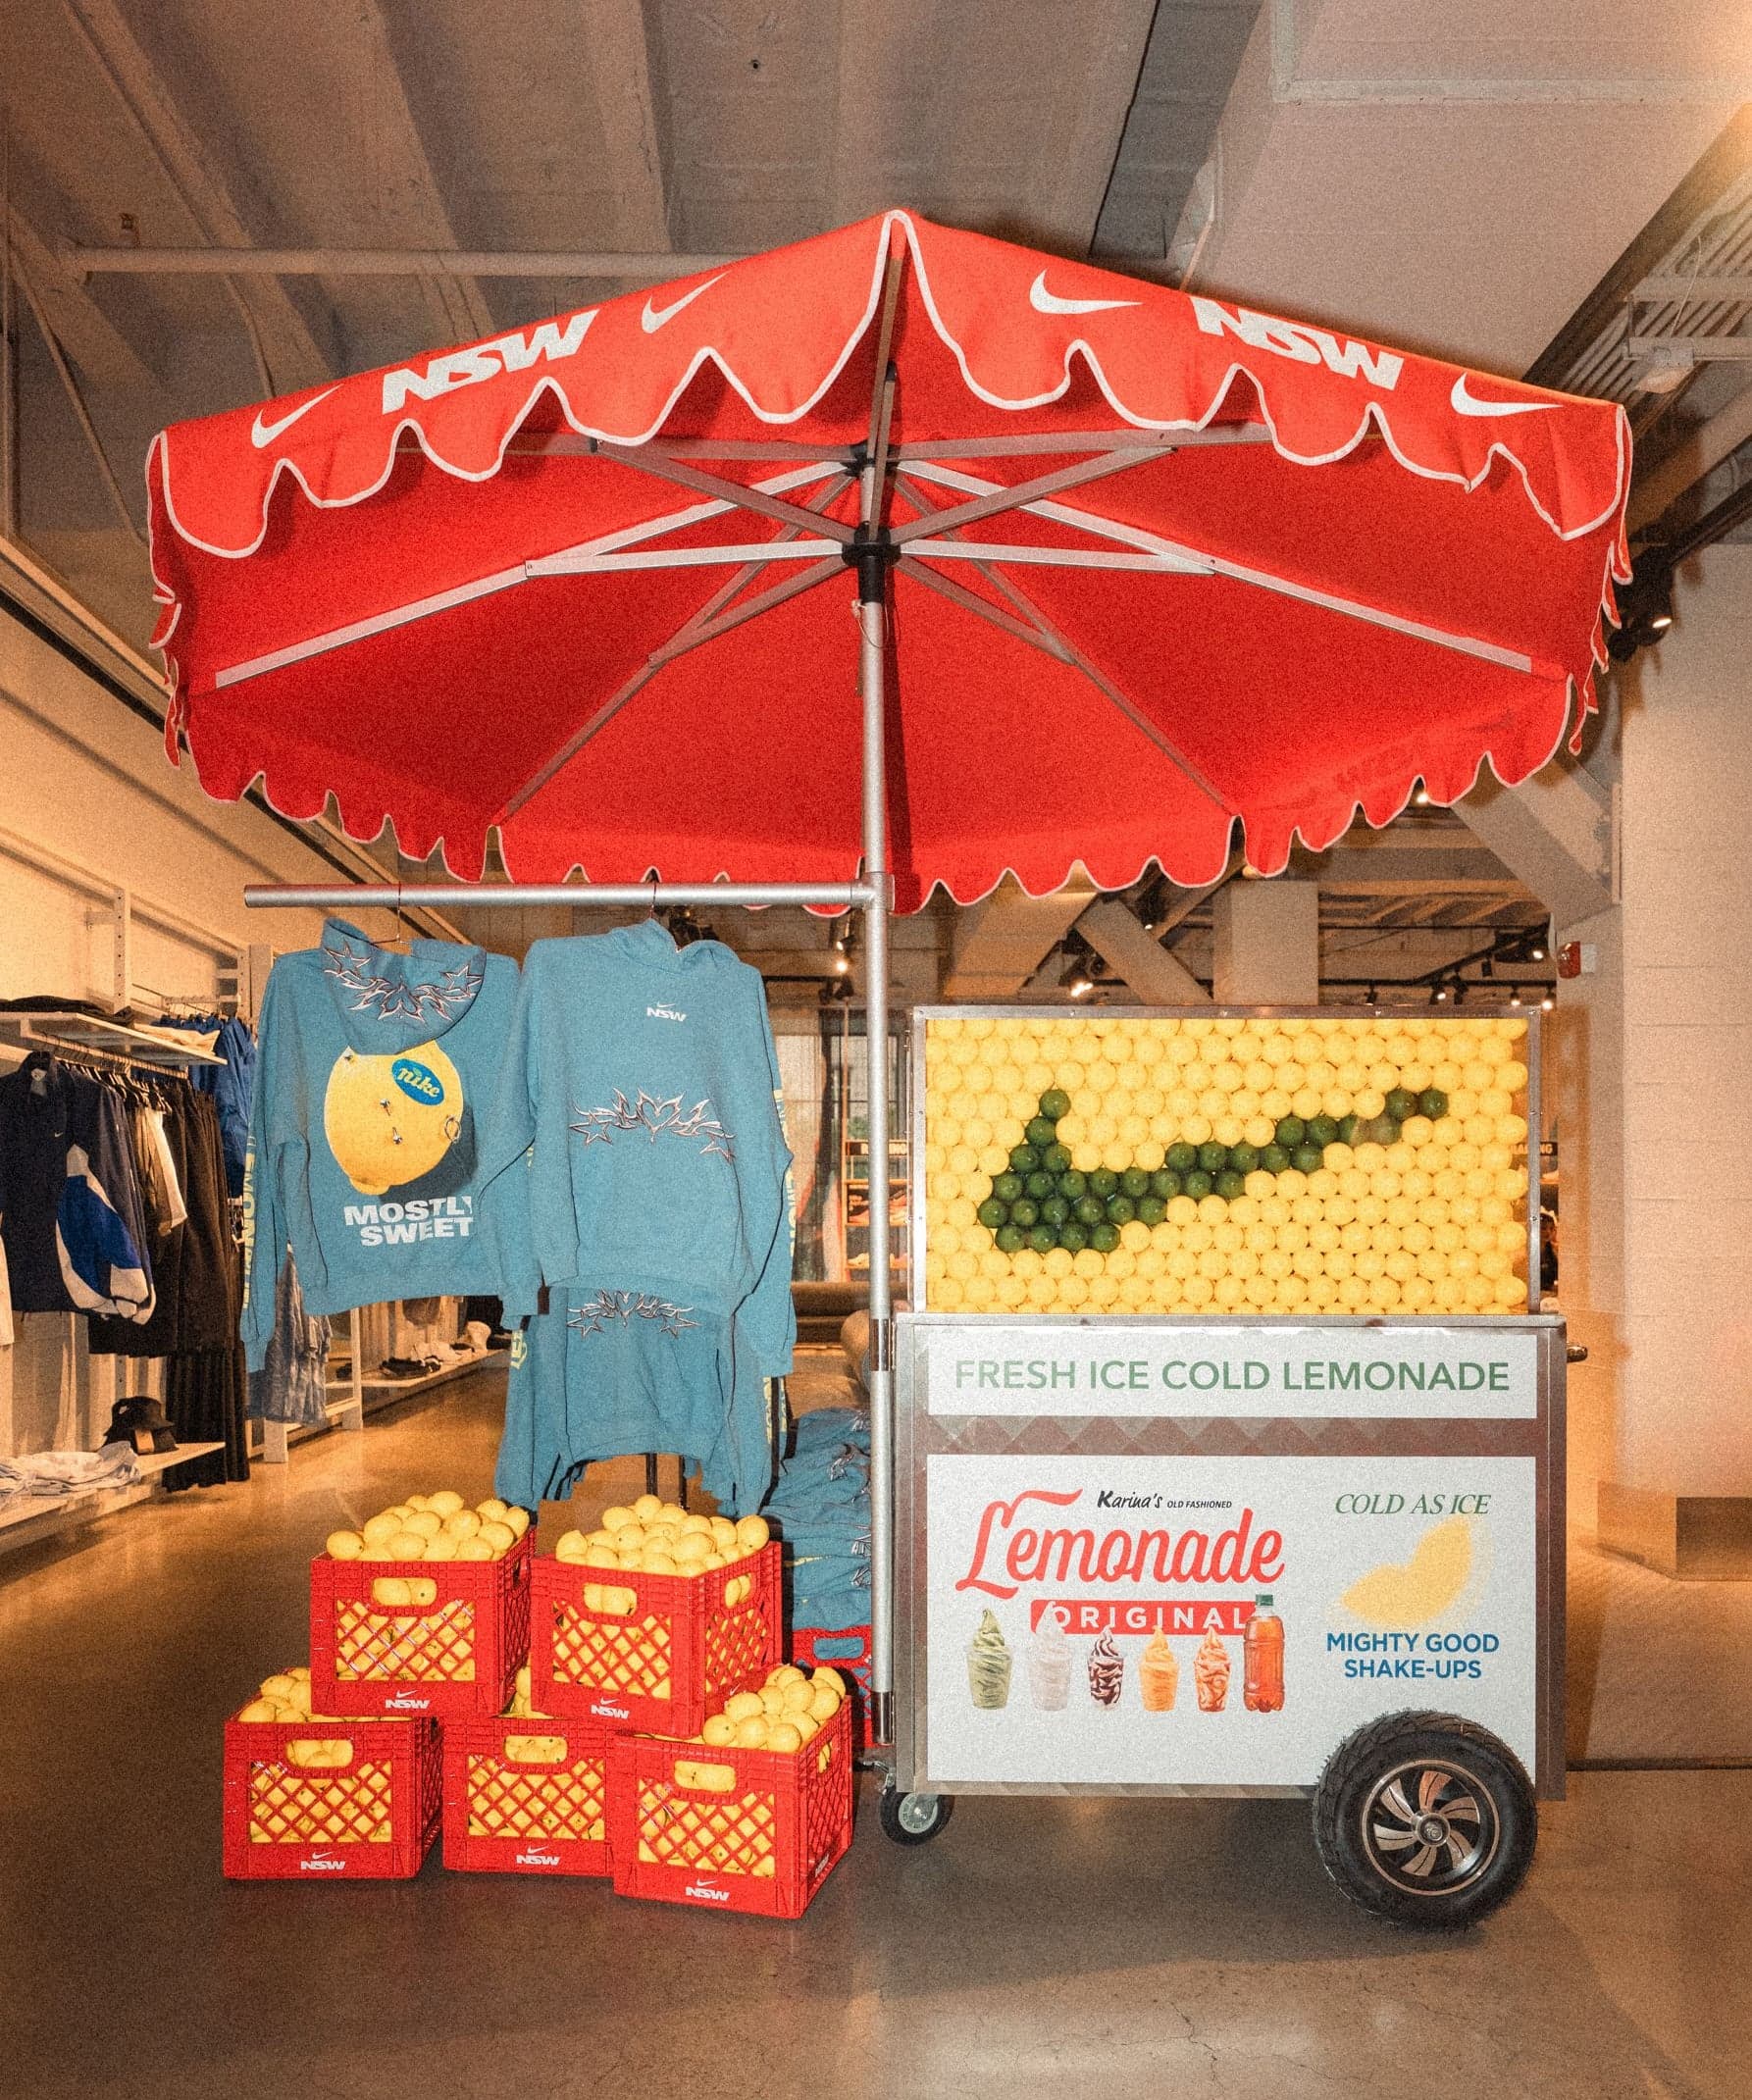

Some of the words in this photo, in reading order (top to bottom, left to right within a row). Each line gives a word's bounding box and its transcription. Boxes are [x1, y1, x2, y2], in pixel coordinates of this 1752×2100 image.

[1189, 296, 1404, 389] NSW
[382, 309, 600, 414] NSW
[646, 1006, 687, 1021] NSW
[396, 1066, 440, 1098] nike
[360, 1216, 474, 1246] SWEET
[955, 1360, 1076, 1389] FRESH
[1090, 1360, 1150, 1389] ICE
[1161, 1360, 1270, 1391] COLD
[1283, 1360, 1510, 1391] LEMONADE
[1166, 1500, 1184, 1509] OLD
[1186, 1500, 1232, 1509] FASHIONED
[1335, 1494, 1405, 1514] COLD
[1411, 1494, 1445, 1514] AS
[1451, 1494, 1492, 1515] ICE
[954, 1488, 1285, 1600] Lemonade
[1052, 1606, 1249, 1629] ORIGINAL
[1326, 1632, 1419, 1652] MIGHTY
[1425, 1633, 1500, 1652] GOOD
[1344, 1659, 1482, 1678] SHAKE-UPS
[385, 1699, 431, 1709] NSW
[591, 1705, 630, 1719] NSW
[300, 1860, 345, 1870] NSW
[516, 1855, 560, 1866] NSW
[685, 1886, 730, 1901] NSW
